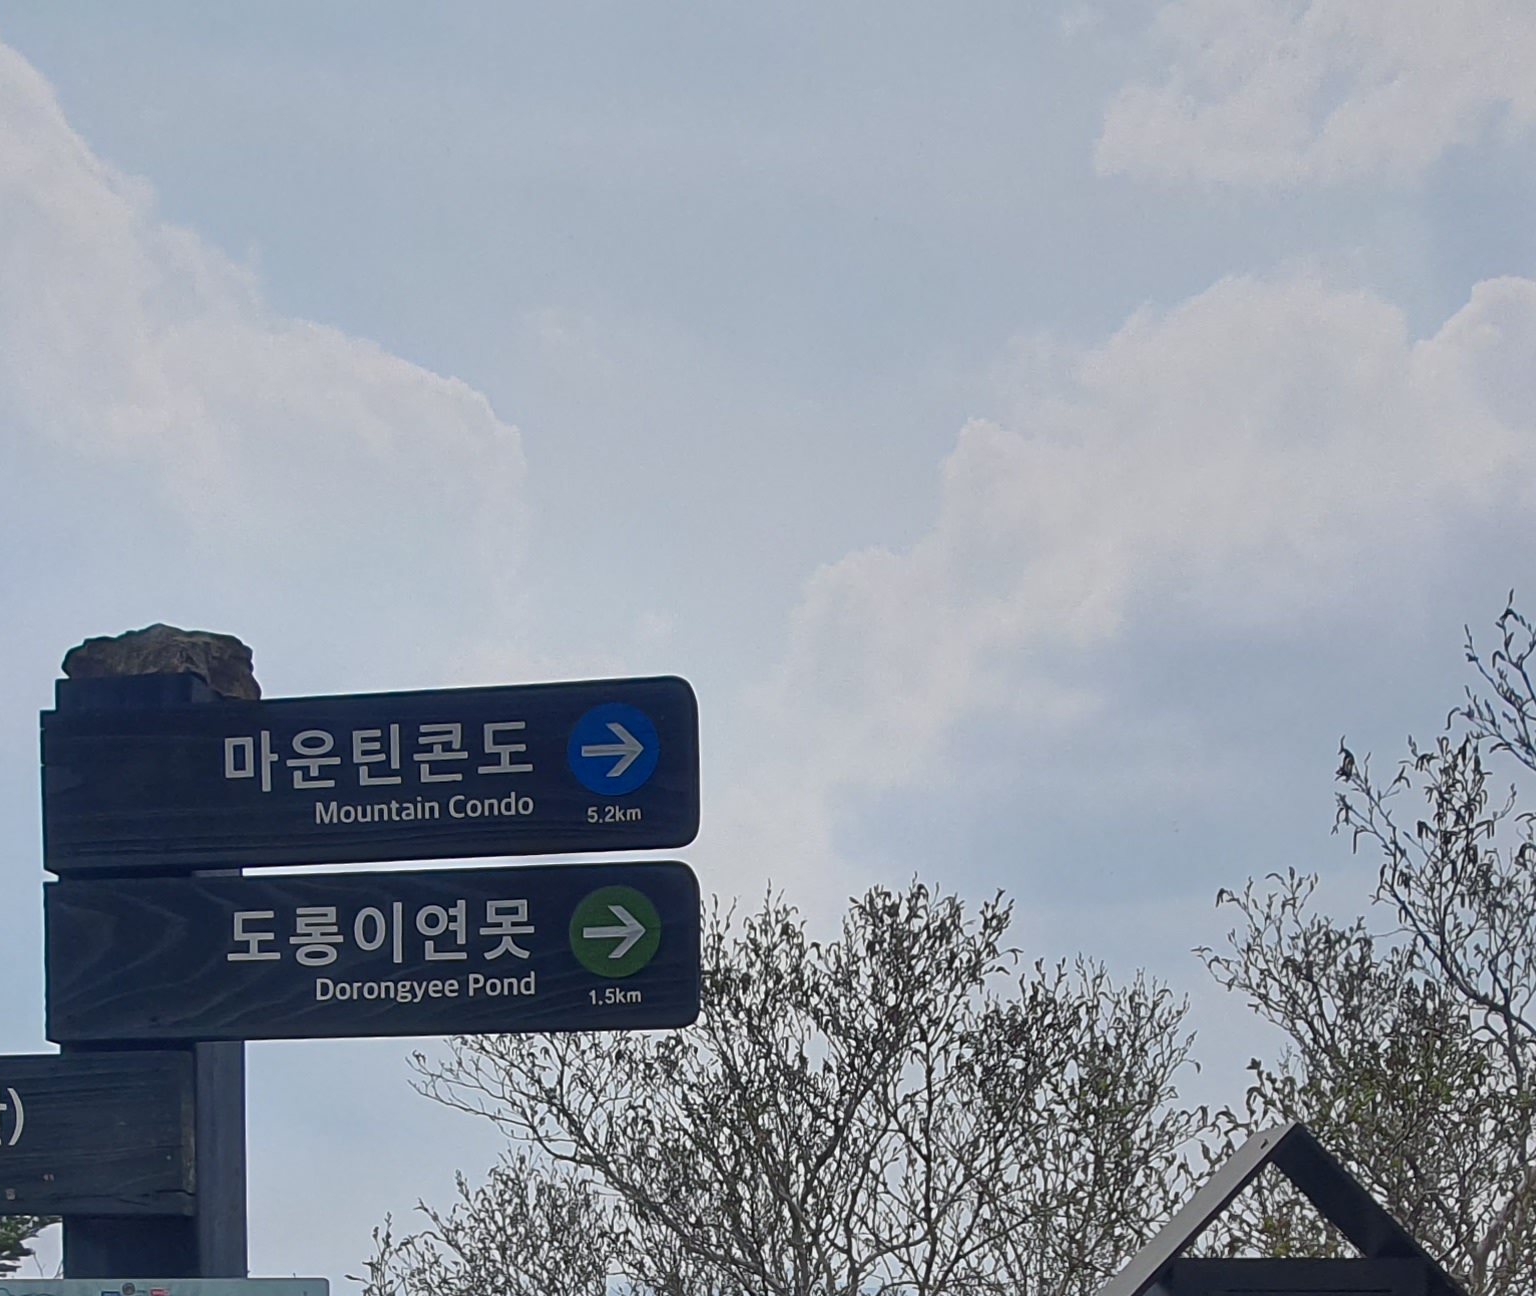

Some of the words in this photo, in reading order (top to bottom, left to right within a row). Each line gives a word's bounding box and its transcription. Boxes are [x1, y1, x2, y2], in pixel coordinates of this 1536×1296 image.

[224, 720, 534, 792] 마운틴콘도
[315, 797, 440, 825] Mountain
[449, 793, 534, 818] Condo
[587, 804, 642, 824] 5.2km
[227, 898, 536, 967] 도롱이연못
[315, 976, 460, 1003] Dorongyee
[468, 971, 536, 996] Pond
[588, 987, 642, 1006] 1.5km
